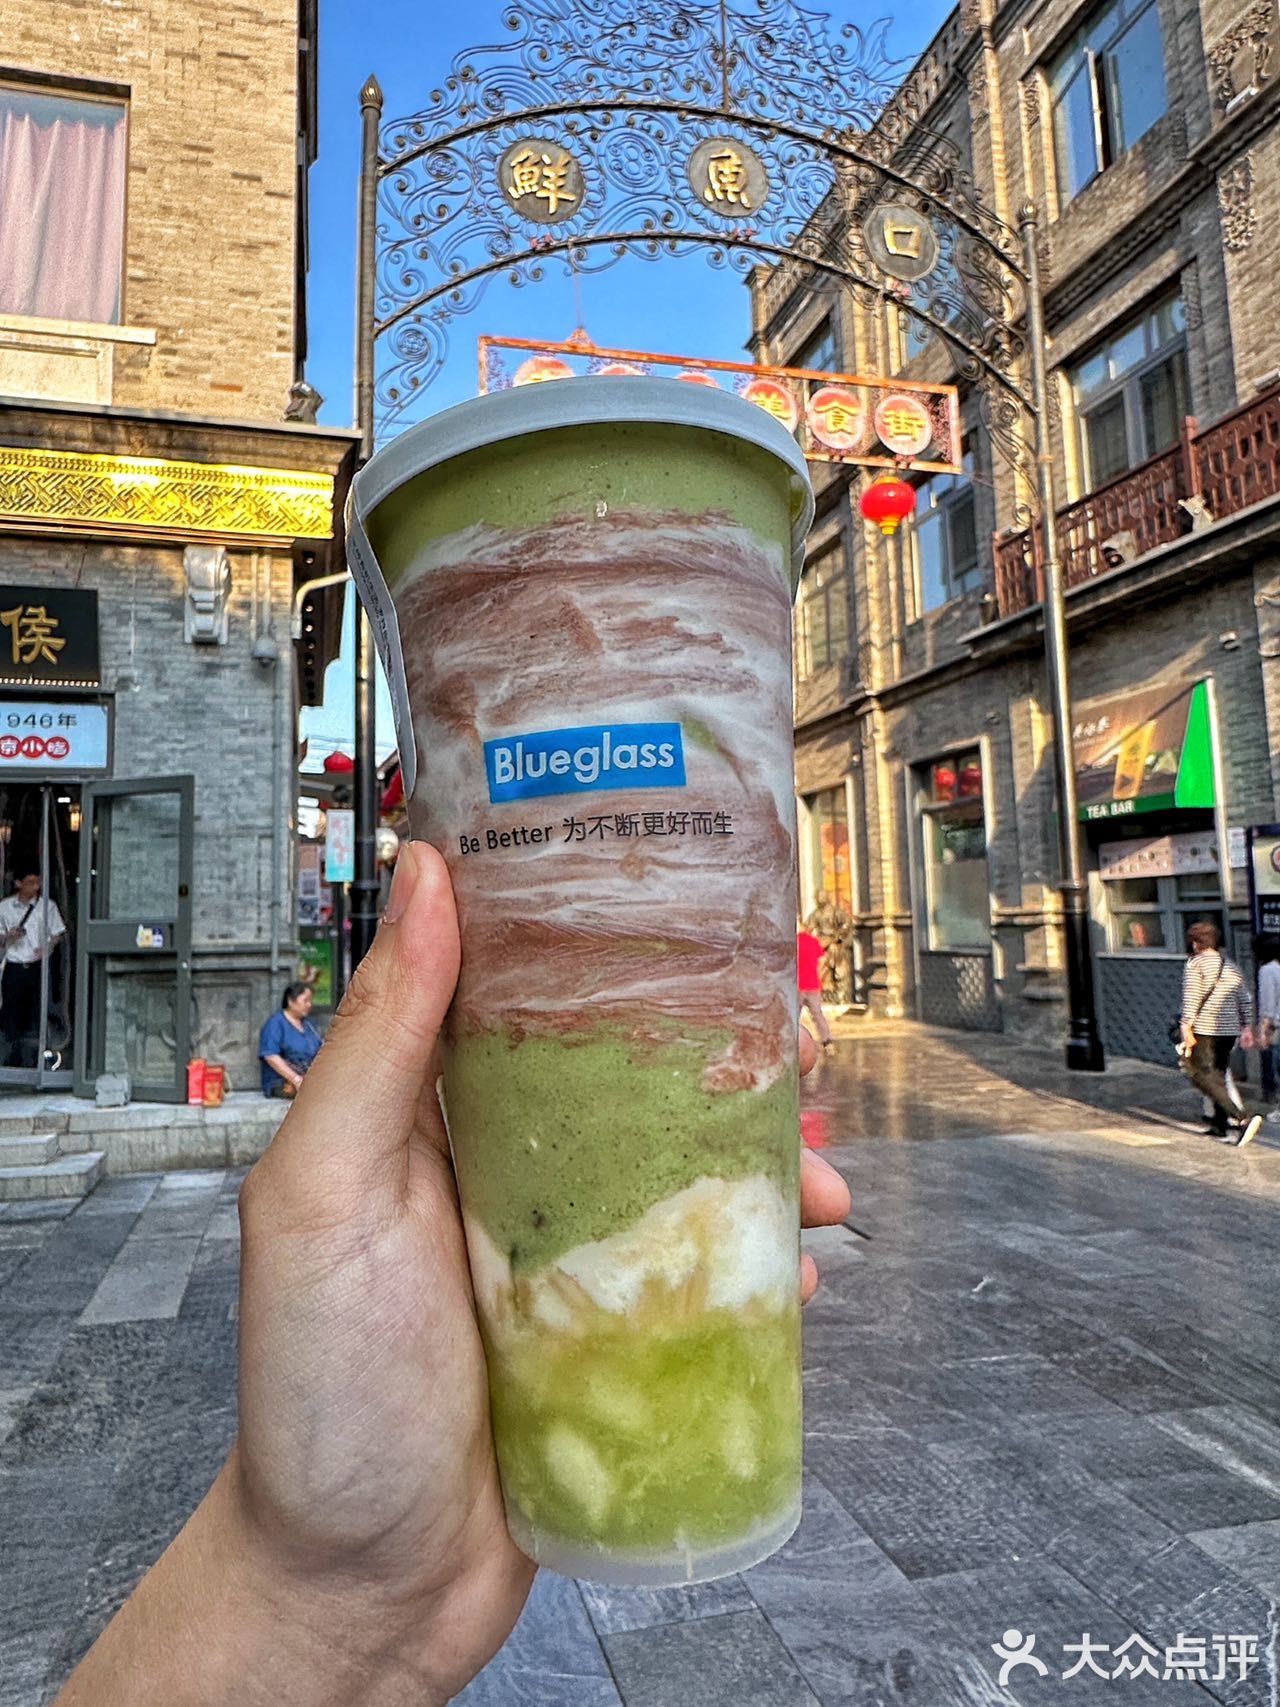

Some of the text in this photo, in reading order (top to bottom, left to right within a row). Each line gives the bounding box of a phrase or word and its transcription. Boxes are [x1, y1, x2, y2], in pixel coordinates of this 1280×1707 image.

[0, 604, 66, 665] 侯
[0, 712, 77, 729] 946年
[494, 731, 675, 784] Blueglass
[1087, 800, 1136, 819] TEA BAR
[459, 810, 735, 855] Be Better 为不断更好而生
